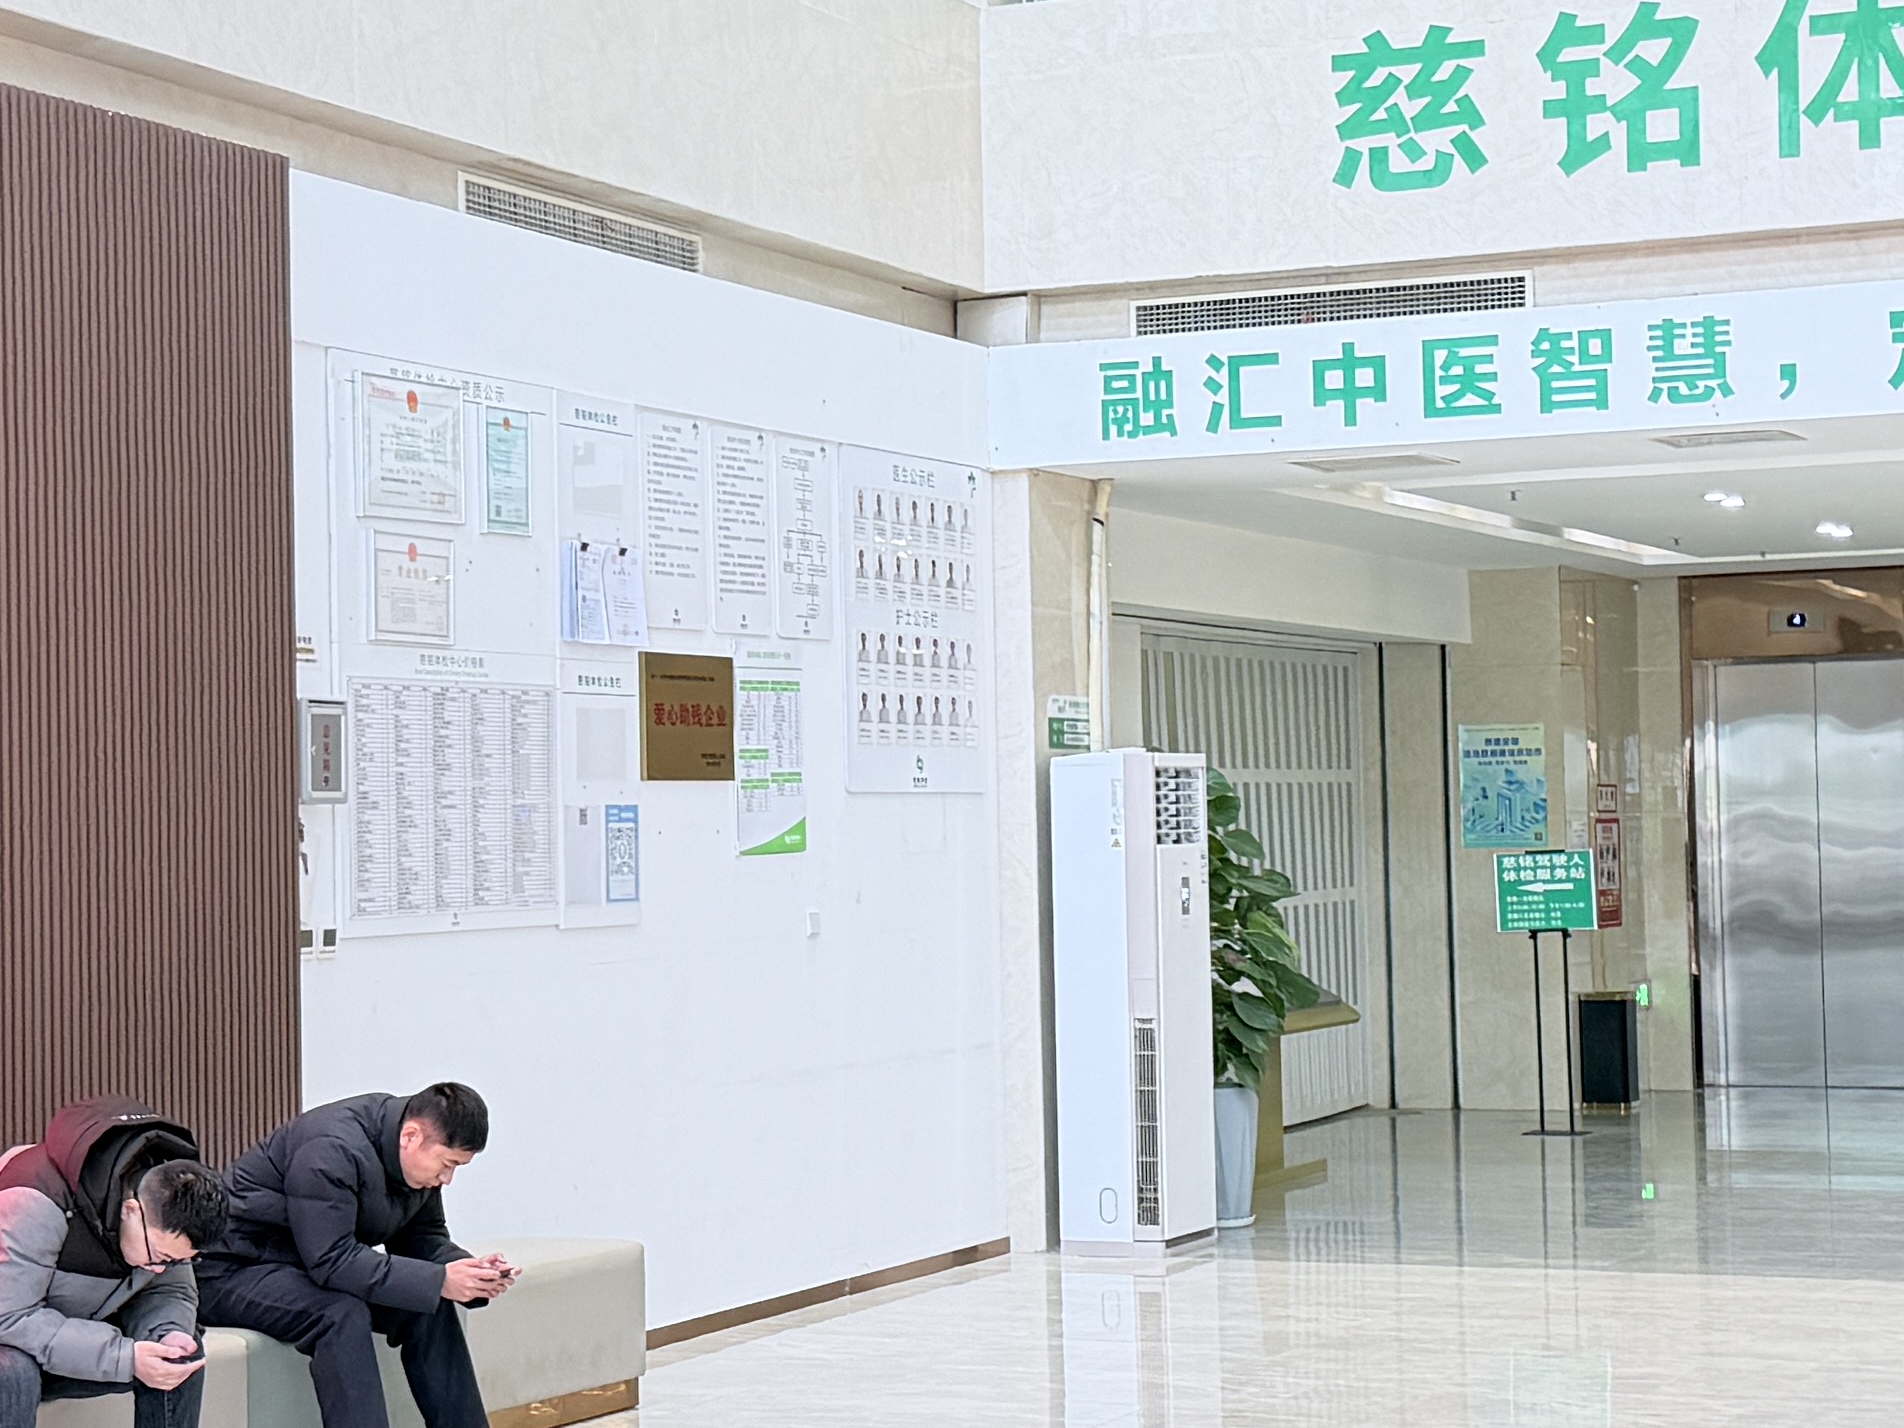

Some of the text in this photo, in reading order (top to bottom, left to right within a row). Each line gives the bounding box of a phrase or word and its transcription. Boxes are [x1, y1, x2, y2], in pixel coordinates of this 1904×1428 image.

[653, 702, 728, 728] 爱心助残企业
[1502, 867, 1585, 882] 体检服务站
